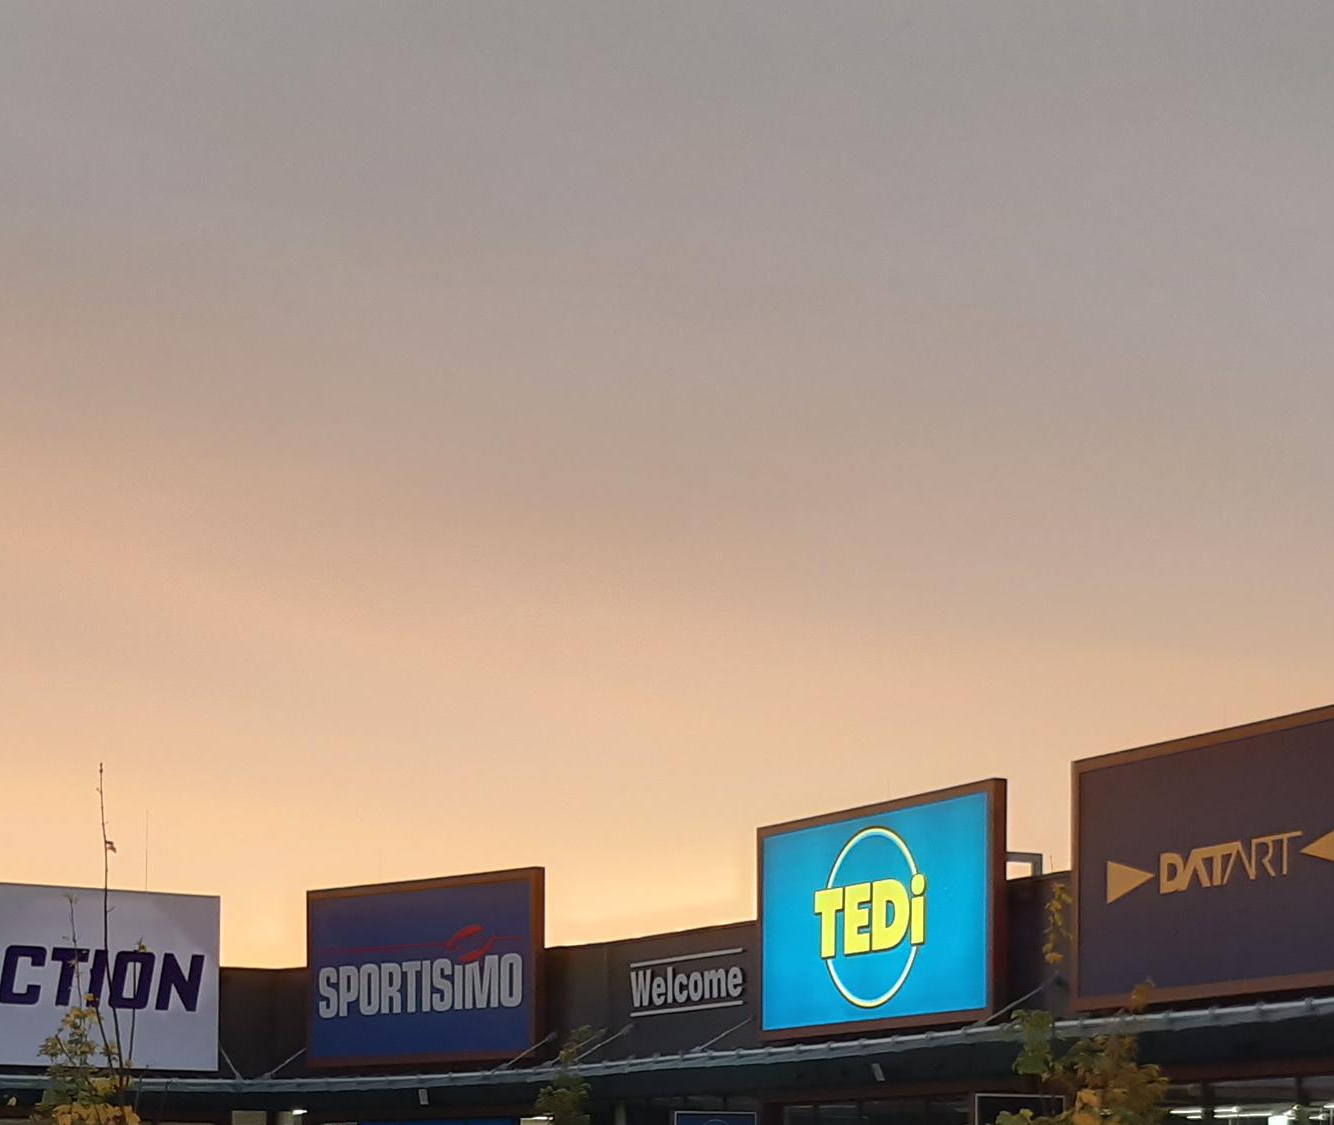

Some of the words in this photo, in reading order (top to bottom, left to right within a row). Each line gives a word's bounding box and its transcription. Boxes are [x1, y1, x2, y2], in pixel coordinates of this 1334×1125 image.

[1159, 830, 1303, 895] DATART
[814, 873, 926, 960] TEDi
[630, 966, 743, 1008] Welcome
